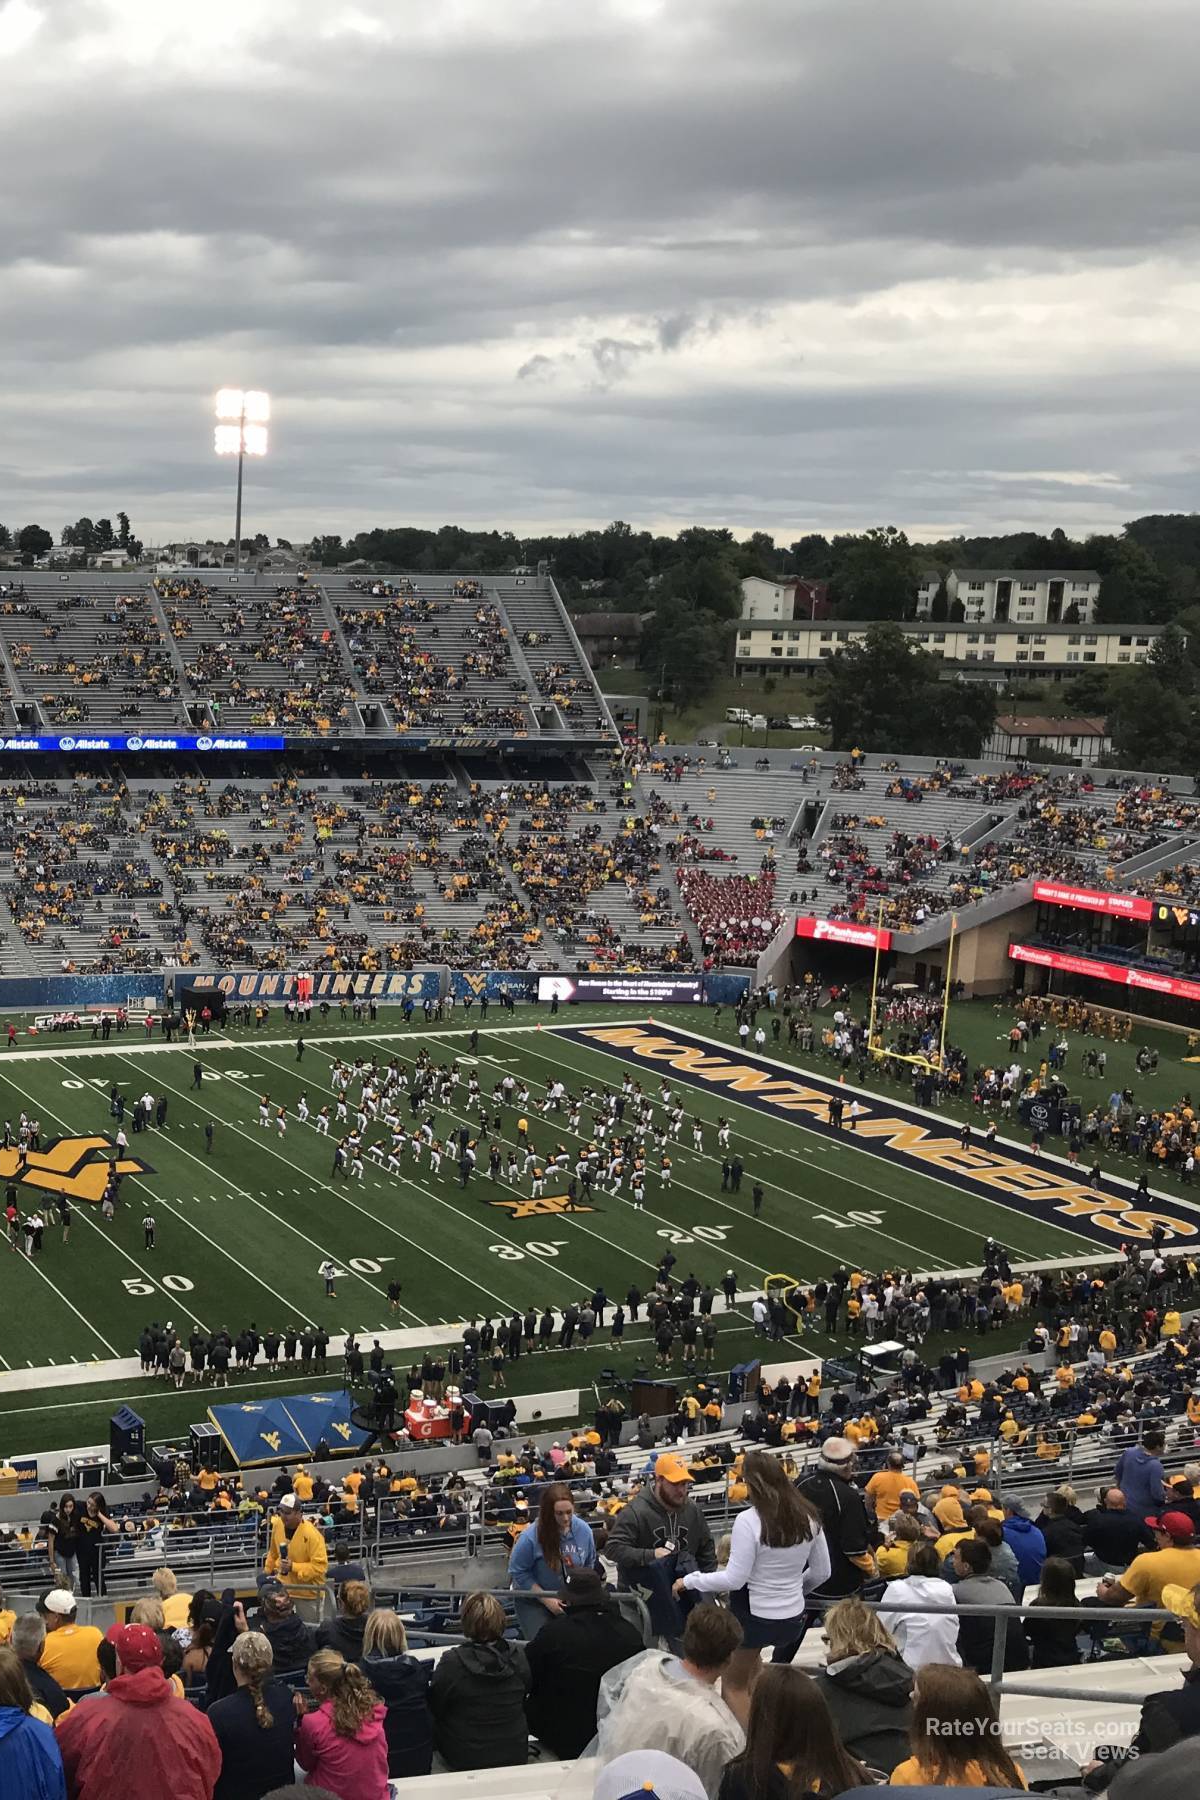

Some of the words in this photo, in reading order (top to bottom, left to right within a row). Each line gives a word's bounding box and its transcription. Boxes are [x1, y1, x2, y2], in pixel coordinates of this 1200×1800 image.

[4, 739, 39, 749] Allstate
[75, 739, 110, 749] Allstate
[142, 739, 177, 749] Allstate
[212, 739, 247, 749] Allstate
[1108, 897, 1134, 909] STAPLES
[1158, 906, 1168, 920] 0
[603, 988, 629, 996] Starting
[580, 1027, 1198, 1239] MOUNTAINEERS
[812, 1211, 883, 1230] 10
[656, 1225, 726, 1246] 20
[488, 1240, 559, 1261] 30
[120, 1274, 195, 1296] 50
[421, 1423, 432, 1436] G
